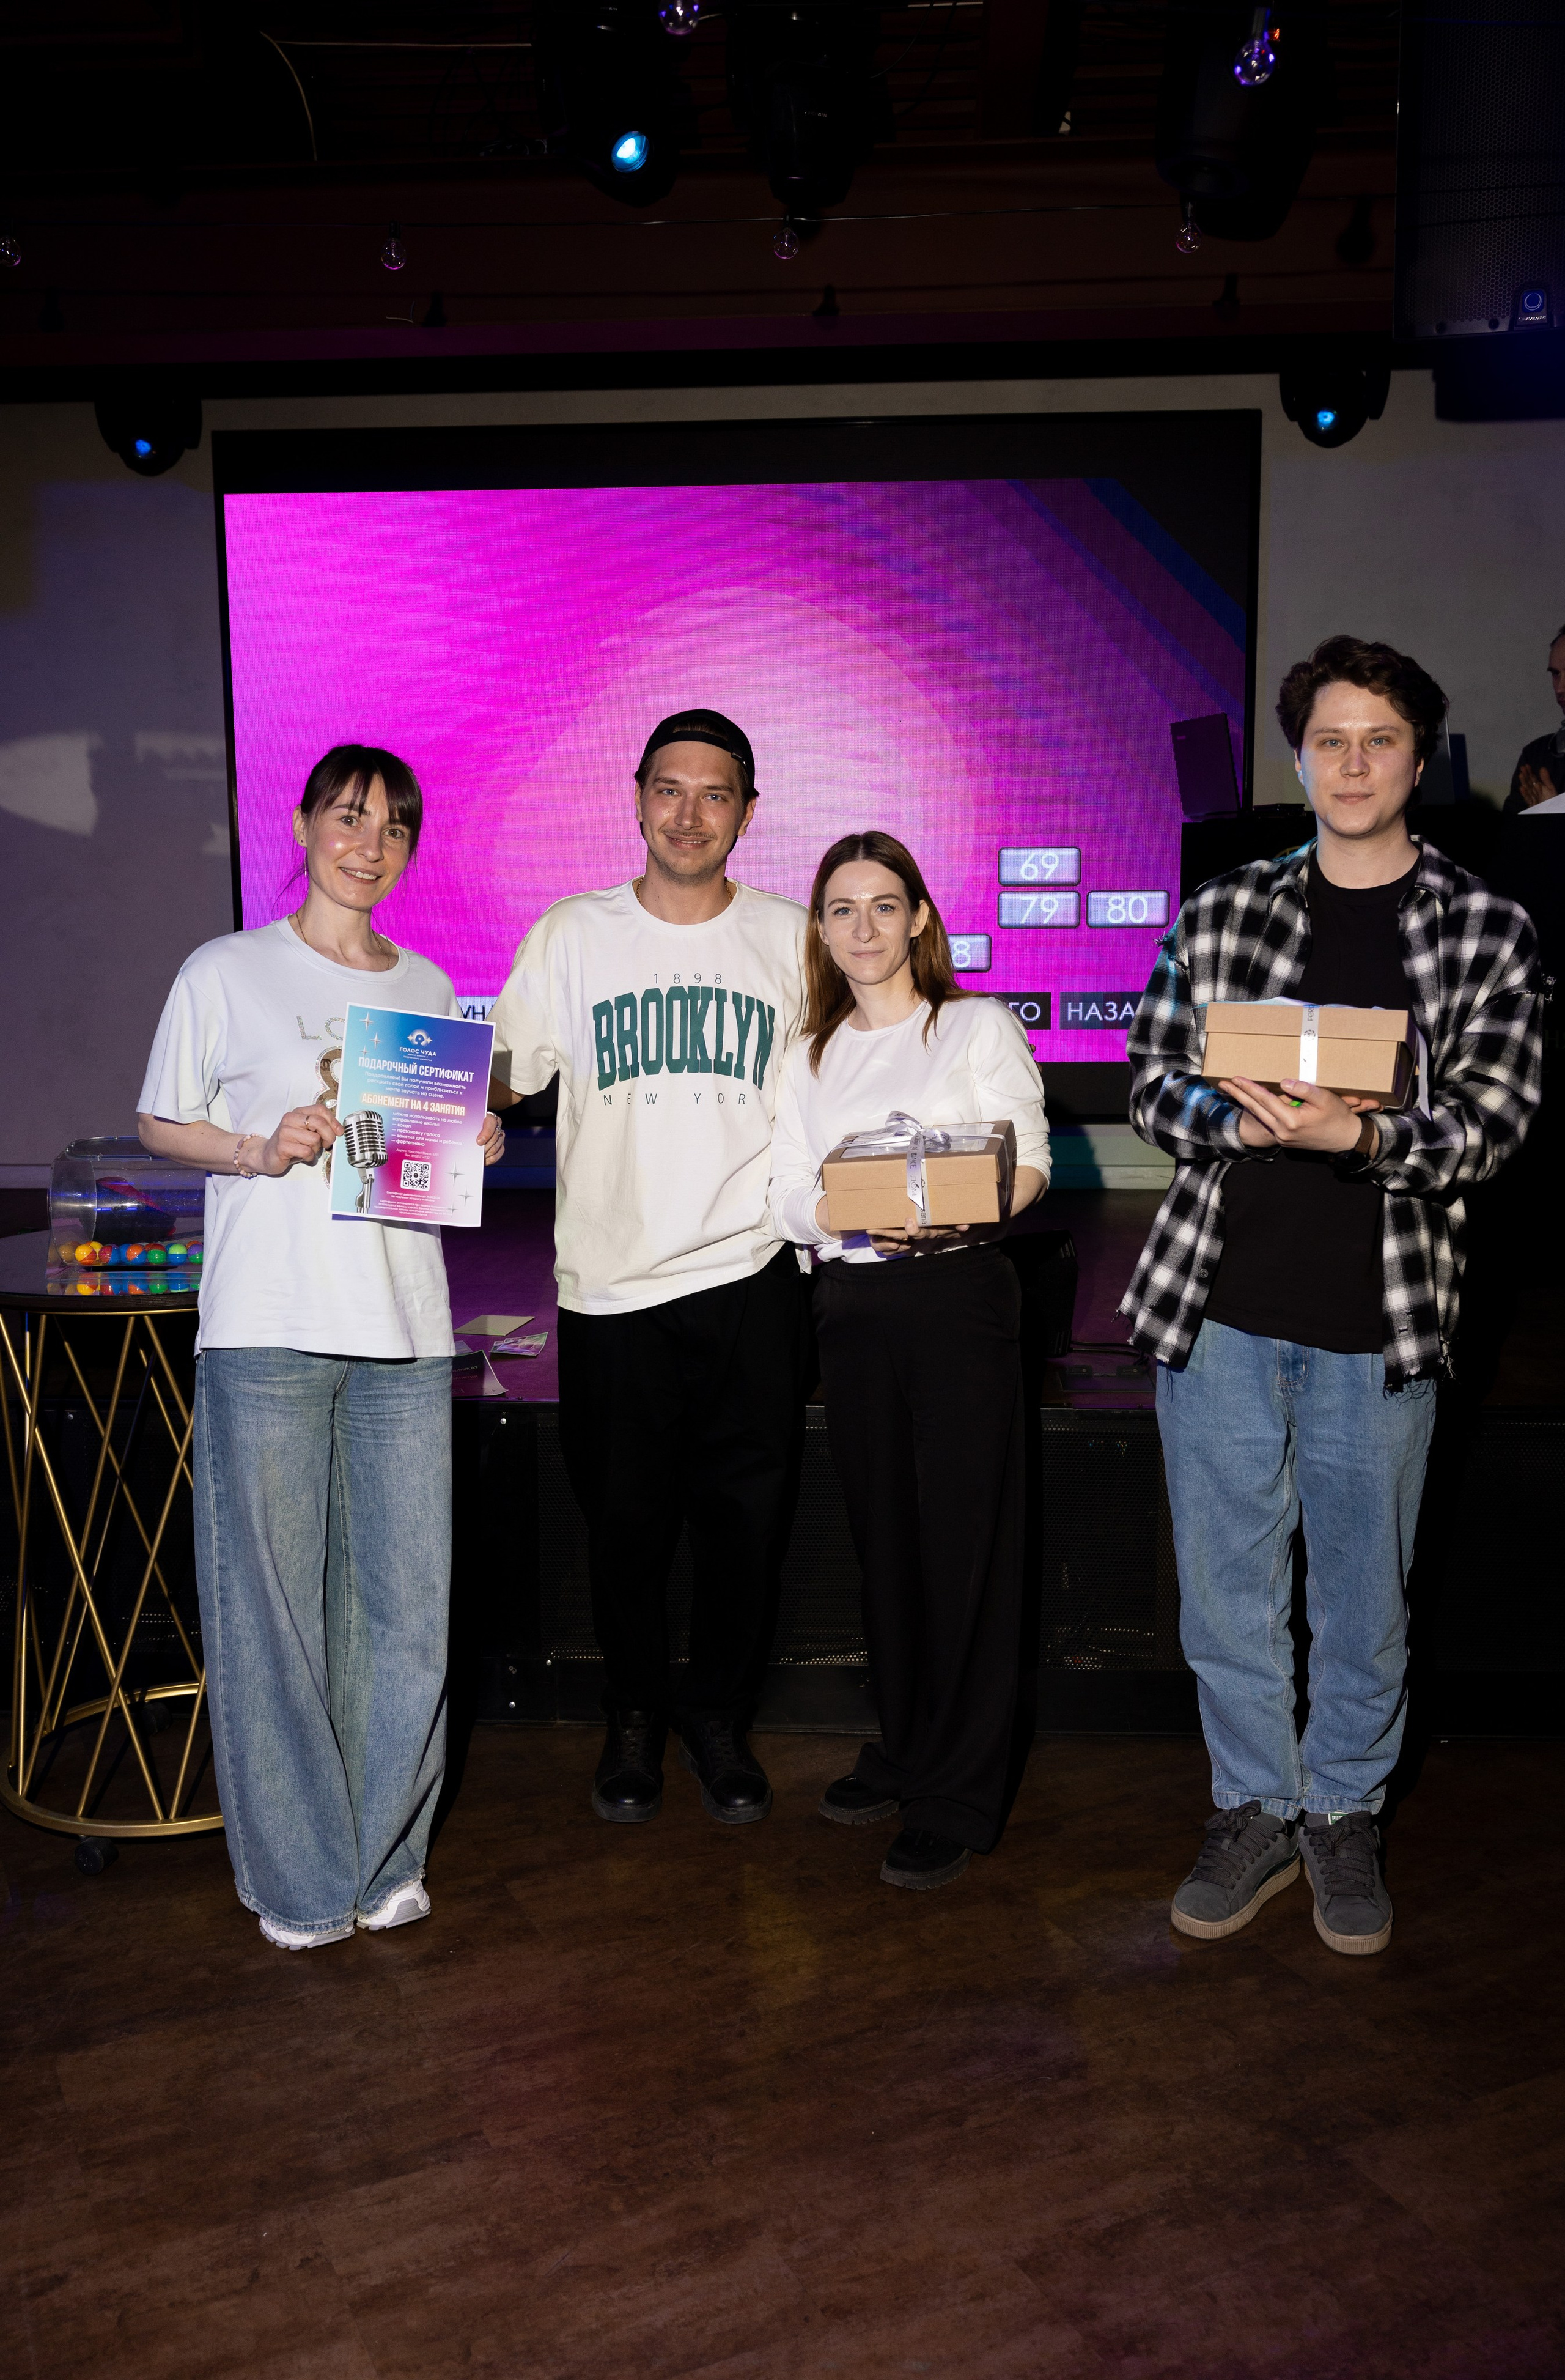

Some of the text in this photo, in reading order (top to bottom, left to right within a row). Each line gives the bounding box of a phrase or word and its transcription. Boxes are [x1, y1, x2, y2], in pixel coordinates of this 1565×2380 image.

[1020, 852, 1060, 881] 69
[1020, 895, 1147, 924] 79 80
[952, 941, 971, 969] 8
[653, 972, 723, 984] 1898
[592, 985, 776, 1091] BROOKLYN
[358, 1056, 474, 1082] ПОДАРОЧНЫЙ СЕРТИФИКАТ
[364, 1071, 400, 1080] Поздравляем!
[361, 1093, 465, 1115] АБОНЕМЕНТ НА 4 ЗАНЯТИЯ
[603, 1092, 762, 1106] NEW YOR
